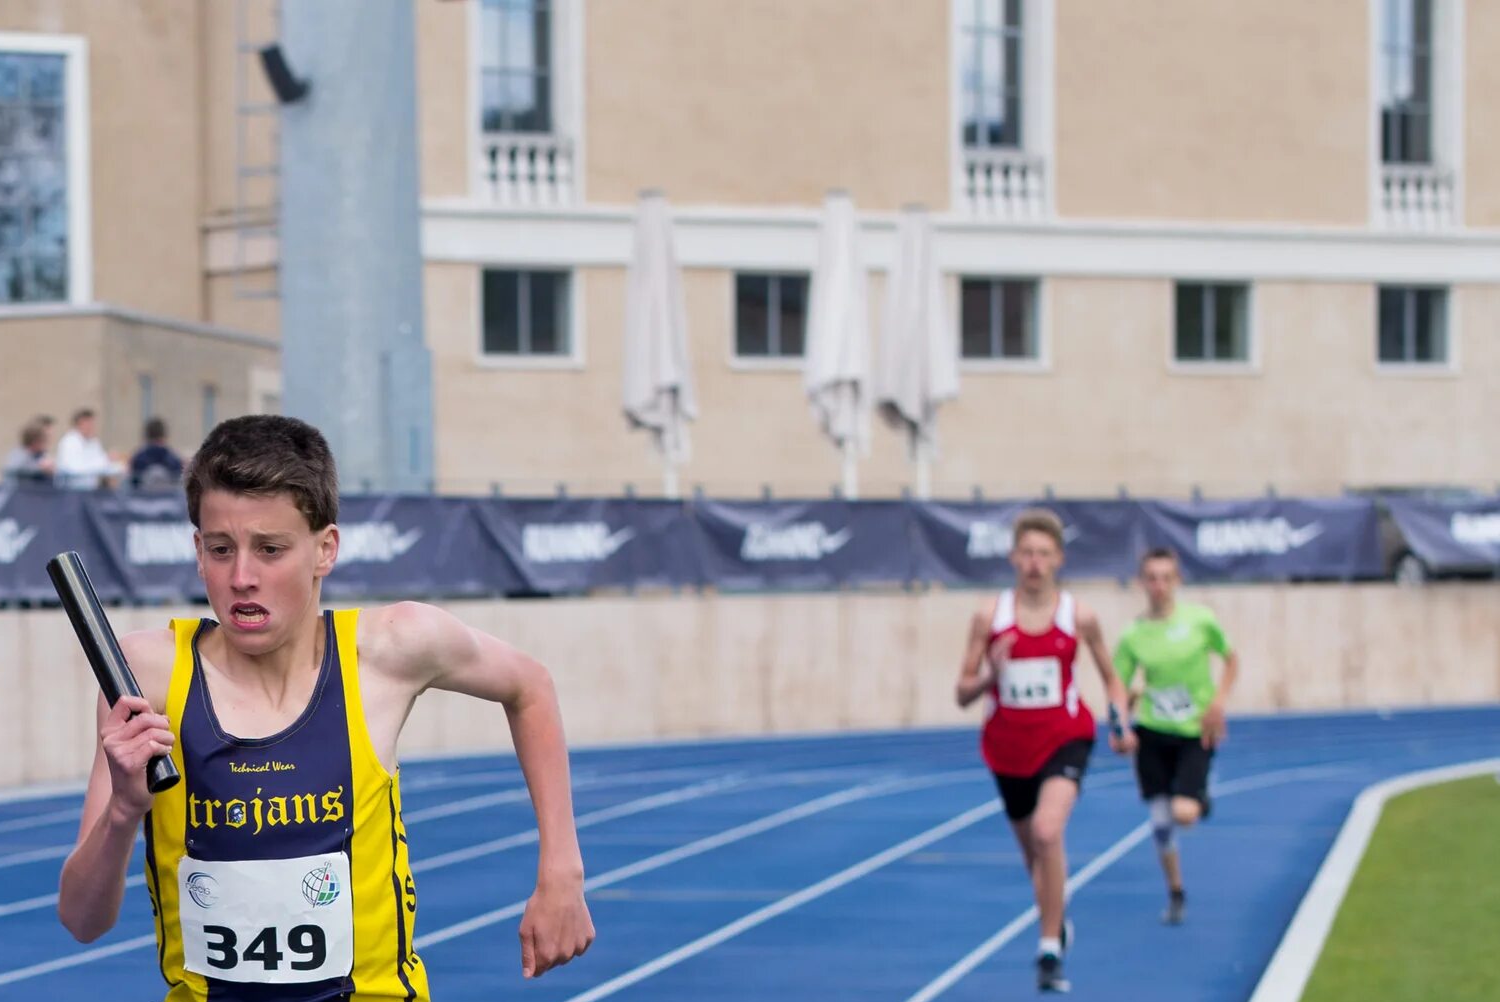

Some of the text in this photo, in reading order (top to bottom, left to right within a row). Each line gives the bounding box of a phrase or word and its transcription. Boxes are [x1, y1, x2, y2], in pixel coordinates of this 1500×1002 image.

[229, 760, 296, 774] Technical Wear
[188, 785, 345, 835] trojans
[203, 924, 326, 971] 349
